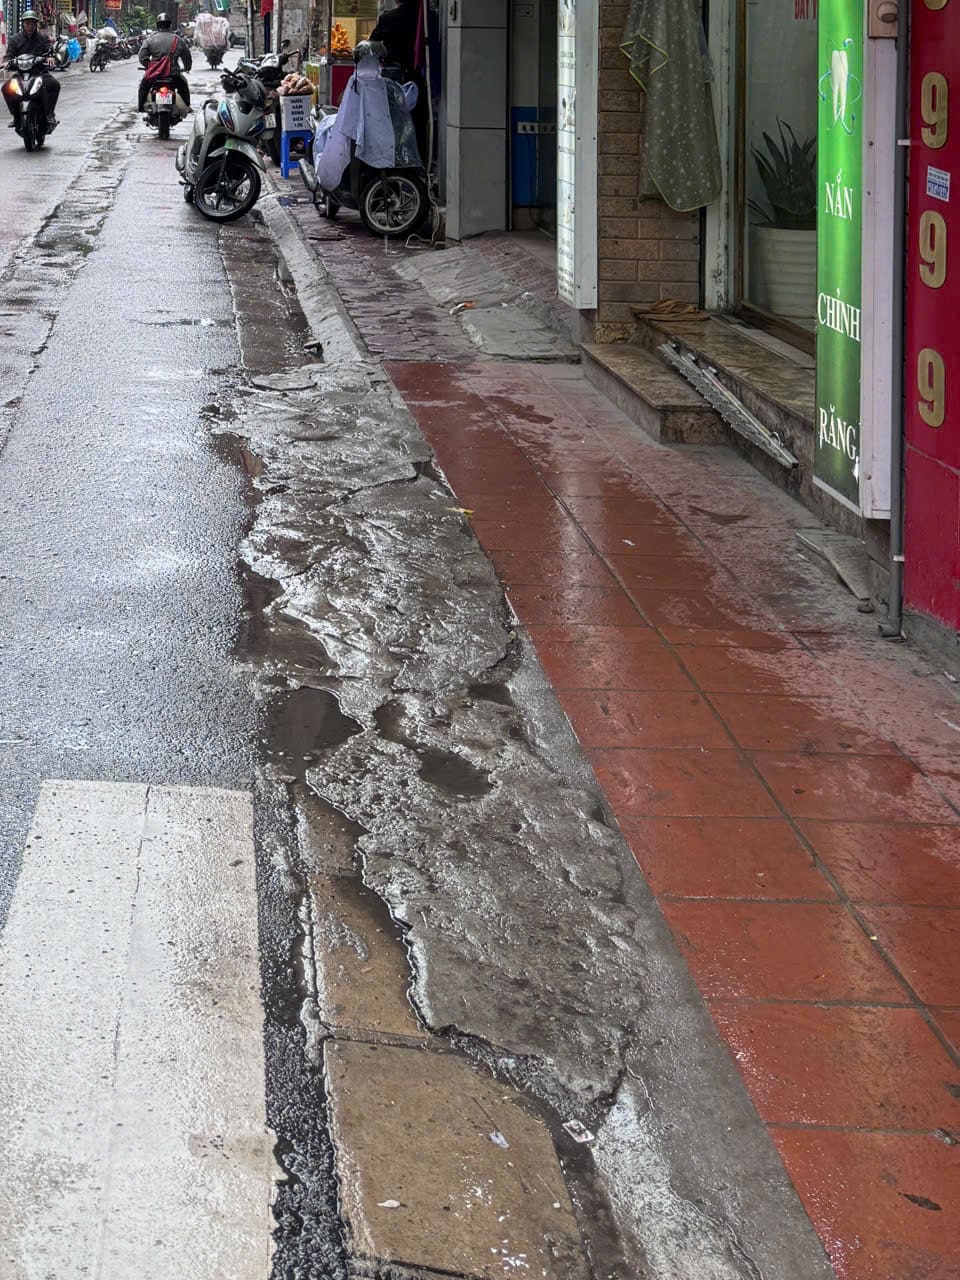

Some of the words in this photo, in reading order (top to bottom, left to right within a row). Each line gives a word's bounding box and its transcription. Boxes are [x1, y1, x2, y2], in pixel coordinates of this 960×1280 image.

[920, 71, 949, 150] 9
[919, 210, 947, 289] 9
[817, 288, 861, 342] CHỈNH
[917, 347, 945, 427] 9
[819, 404, 859, 460] RĂNG
